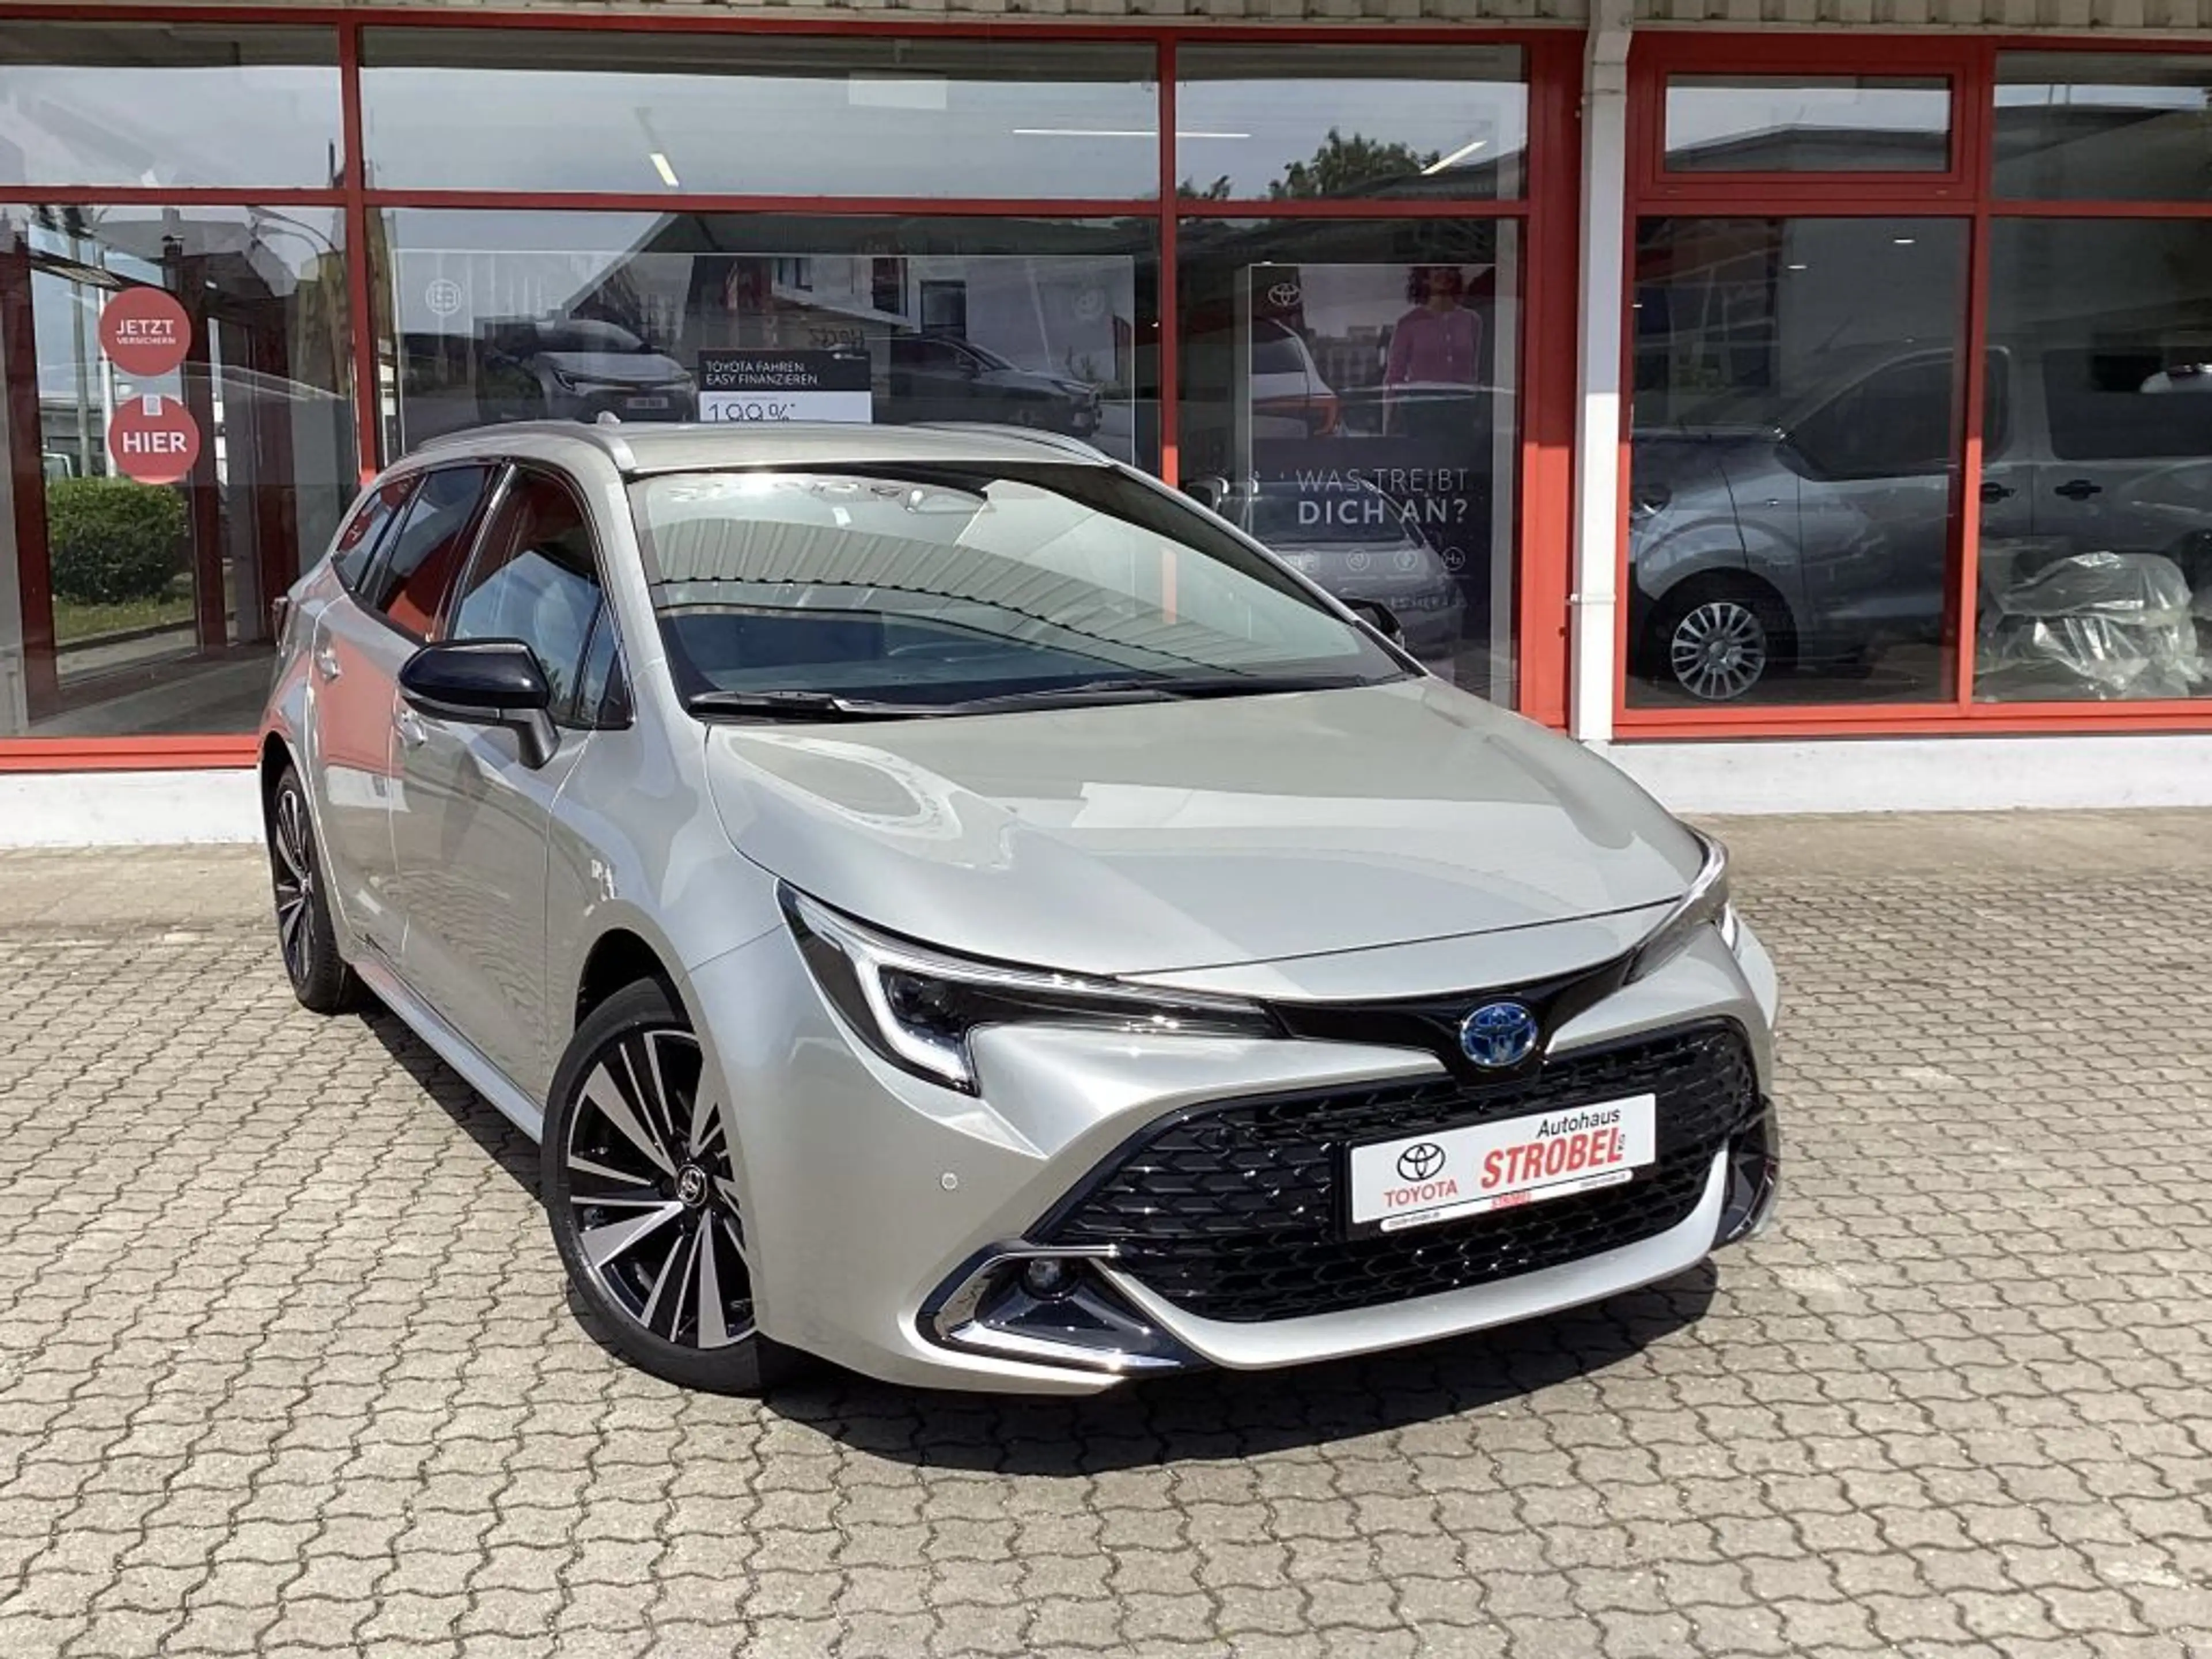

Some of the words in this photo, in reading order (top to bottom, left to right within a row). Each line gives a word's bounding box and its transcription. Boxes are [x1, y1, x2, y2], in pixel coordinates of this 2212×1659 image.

[116, 319, 175, 334] JETZT
[706, 361, 754, 373] TOYOTA
[706, 374, 735, 385] EASY
[122, 431, 187, 453] HIER
[1296, 468, 1361, 491] WAS
[1373, 468, 1469, 491] TREIBT
[1298, 500, 1384, 524] DICH
[1399, 498, 1469, 524] AN?
[1535, 1108, 1622, 1139] Autohaus
[1481, 1127, 1623, 1189] STROBEL
[1384, 1179, 1459, 1208] TOYOTA
